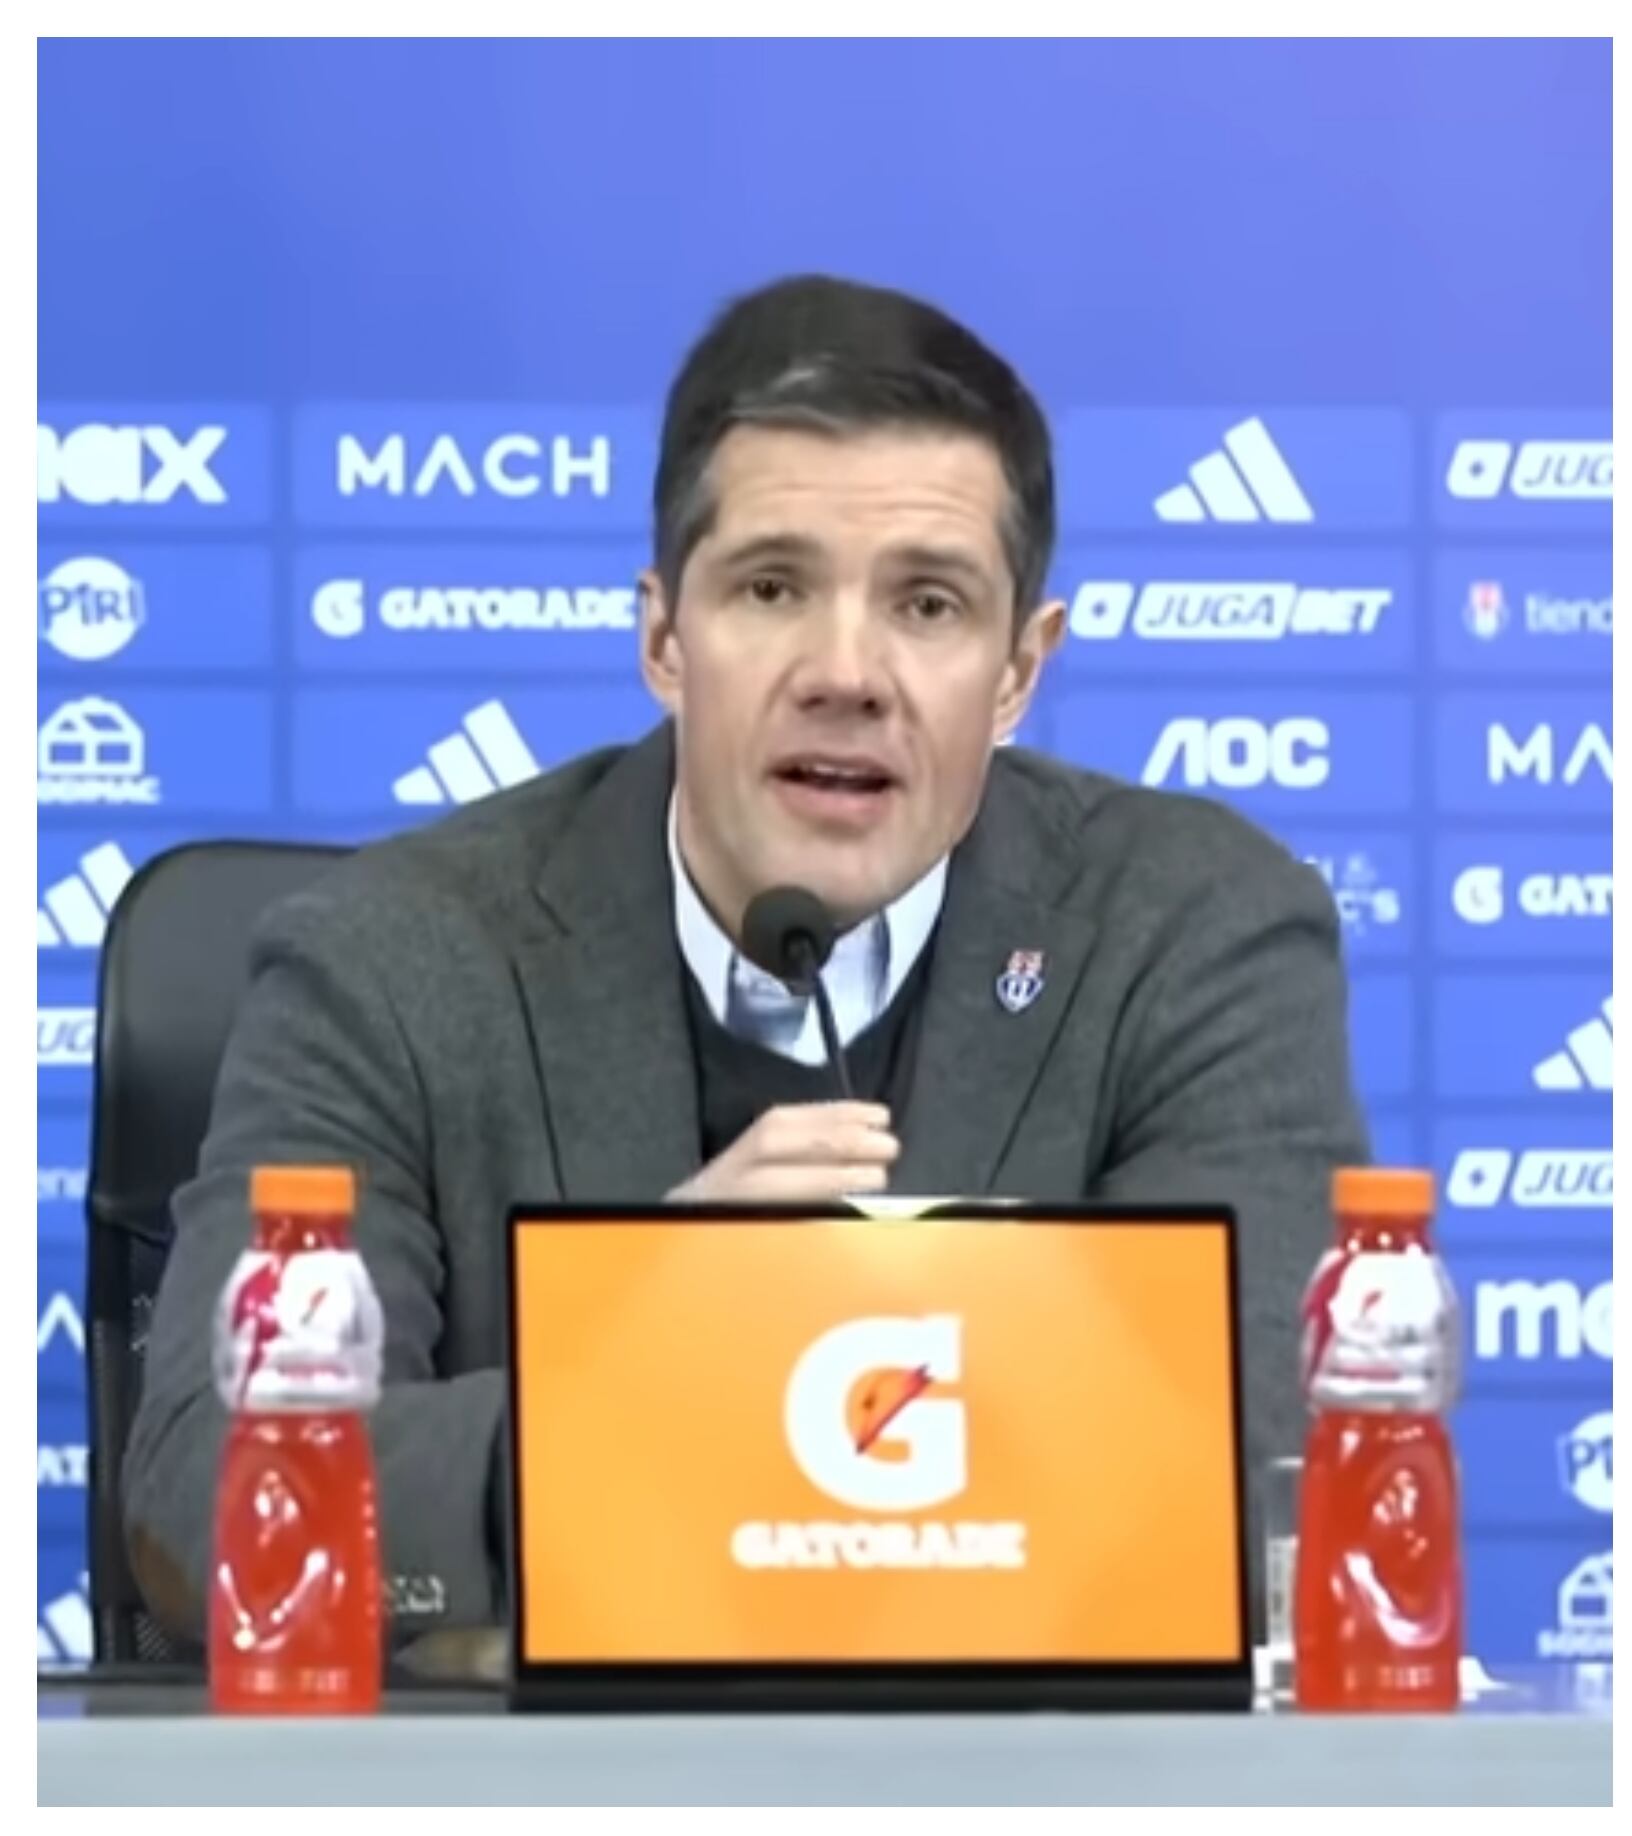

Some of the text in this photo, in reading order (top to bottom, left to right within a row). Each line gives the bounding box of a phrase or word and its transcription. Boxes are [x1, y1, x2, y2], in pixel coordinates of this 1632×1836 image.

[336, 433, 611, 497] MACH
[378, 587, 637, 630] GATORADE
[1139, 717, 1331, 788] AOC
[730, 1521, 1027, 1570] GATORADE
